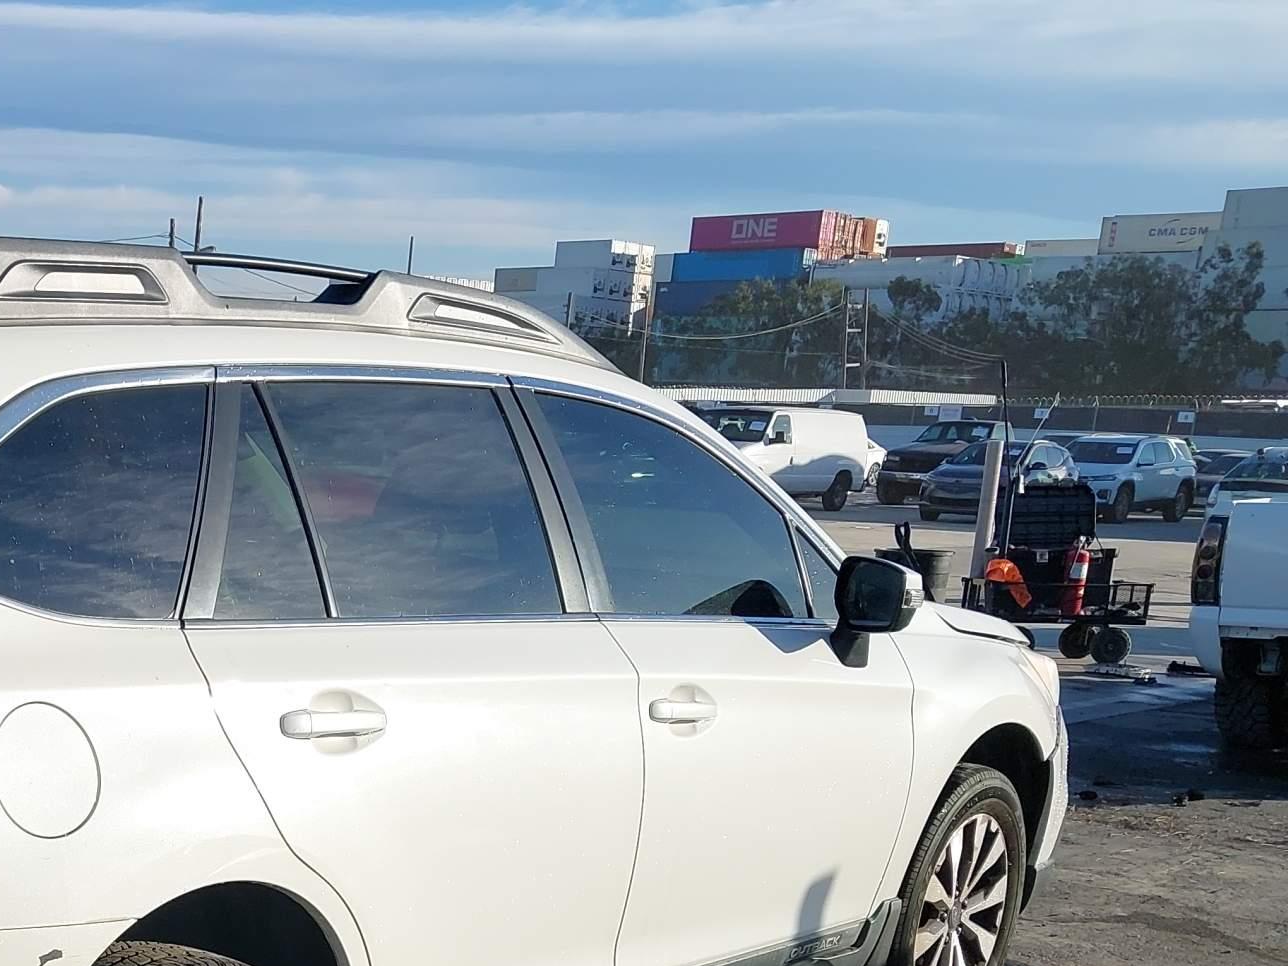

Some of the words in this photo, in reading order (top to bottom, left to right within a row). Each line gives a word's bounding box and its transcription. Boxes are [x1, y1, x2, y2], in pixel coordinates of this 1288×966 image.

[730, 217, 778, 239] ONE
[1148, 227, 1176, 237] CMA
[1179, 226, 1209, 236] CGM
